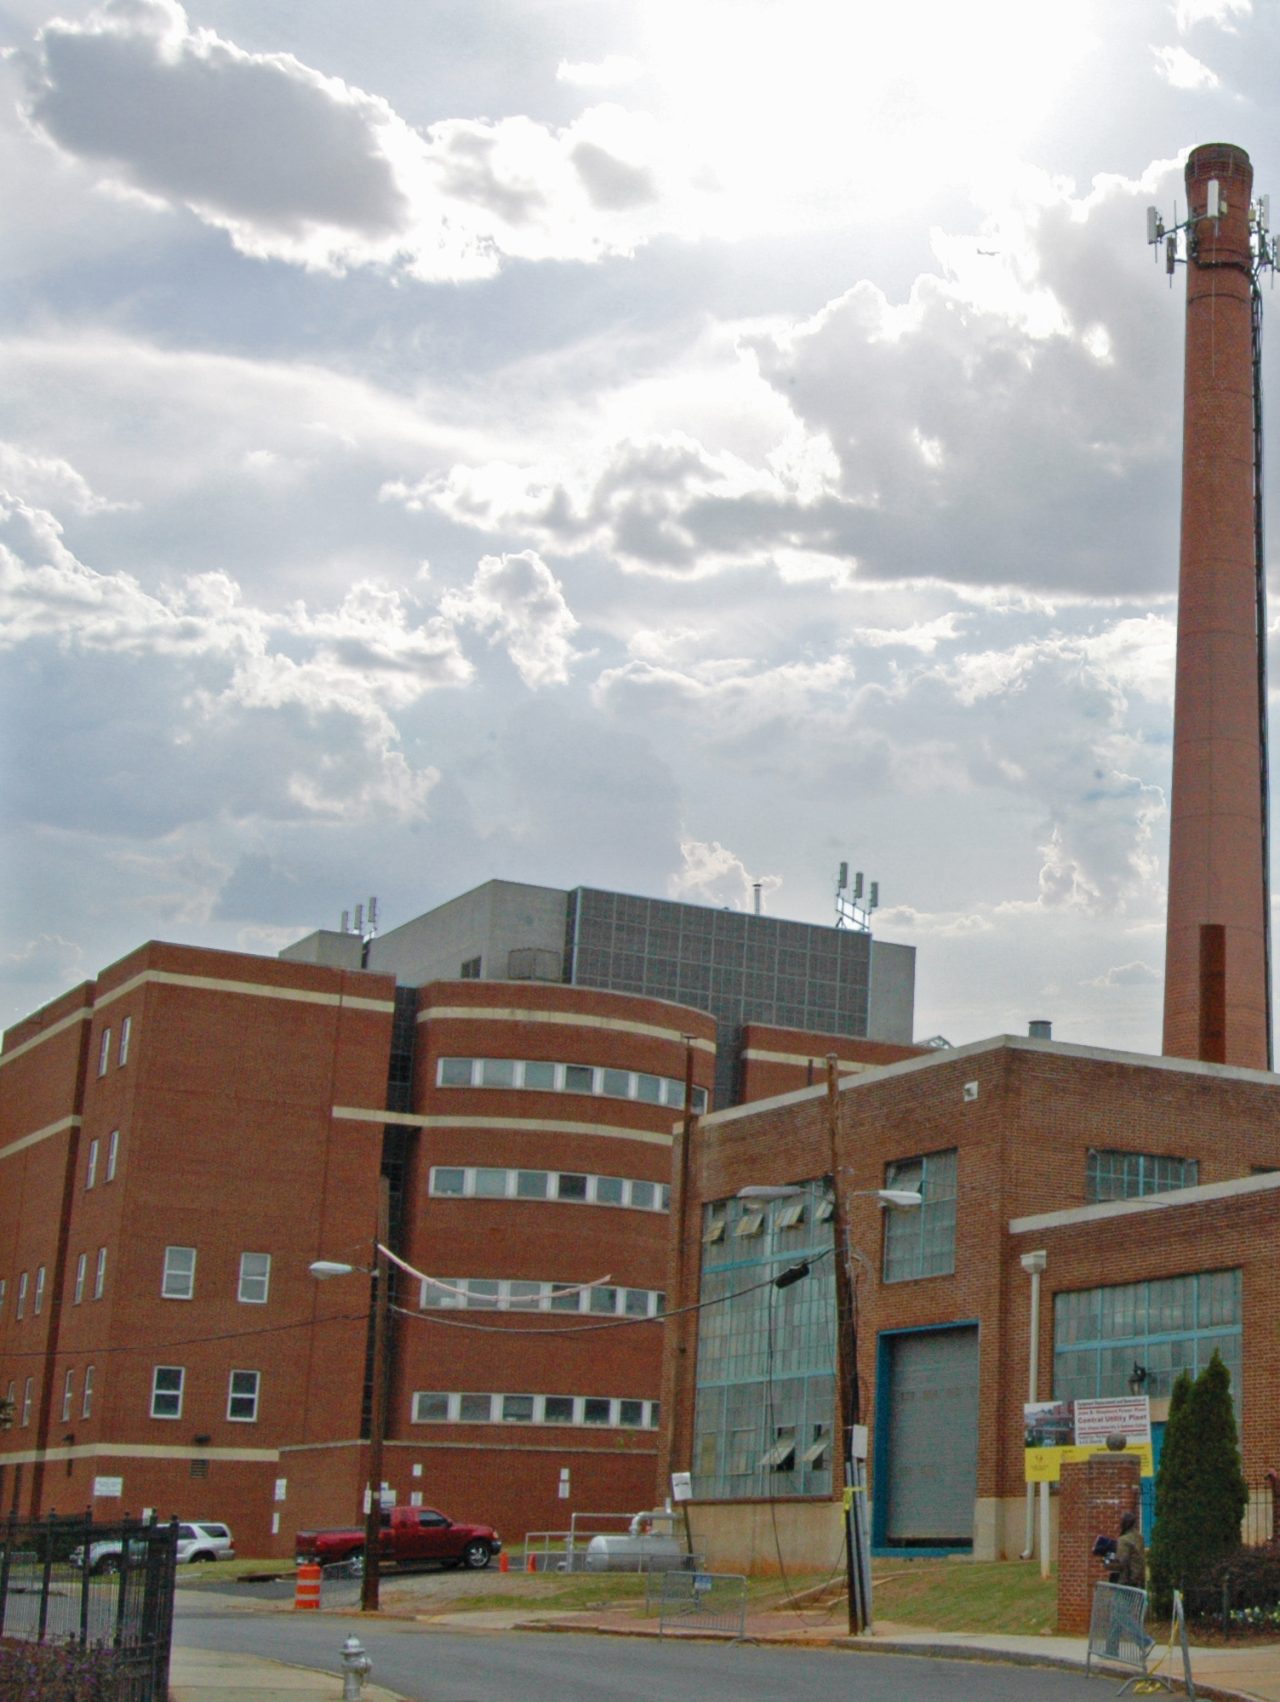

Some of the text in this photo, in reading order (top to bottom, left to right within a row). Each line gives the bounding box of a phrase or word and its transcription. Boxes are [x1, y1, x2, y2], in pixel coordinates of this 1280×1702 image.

[1078, 1413, 1147, 1424] Central Utility Plant
